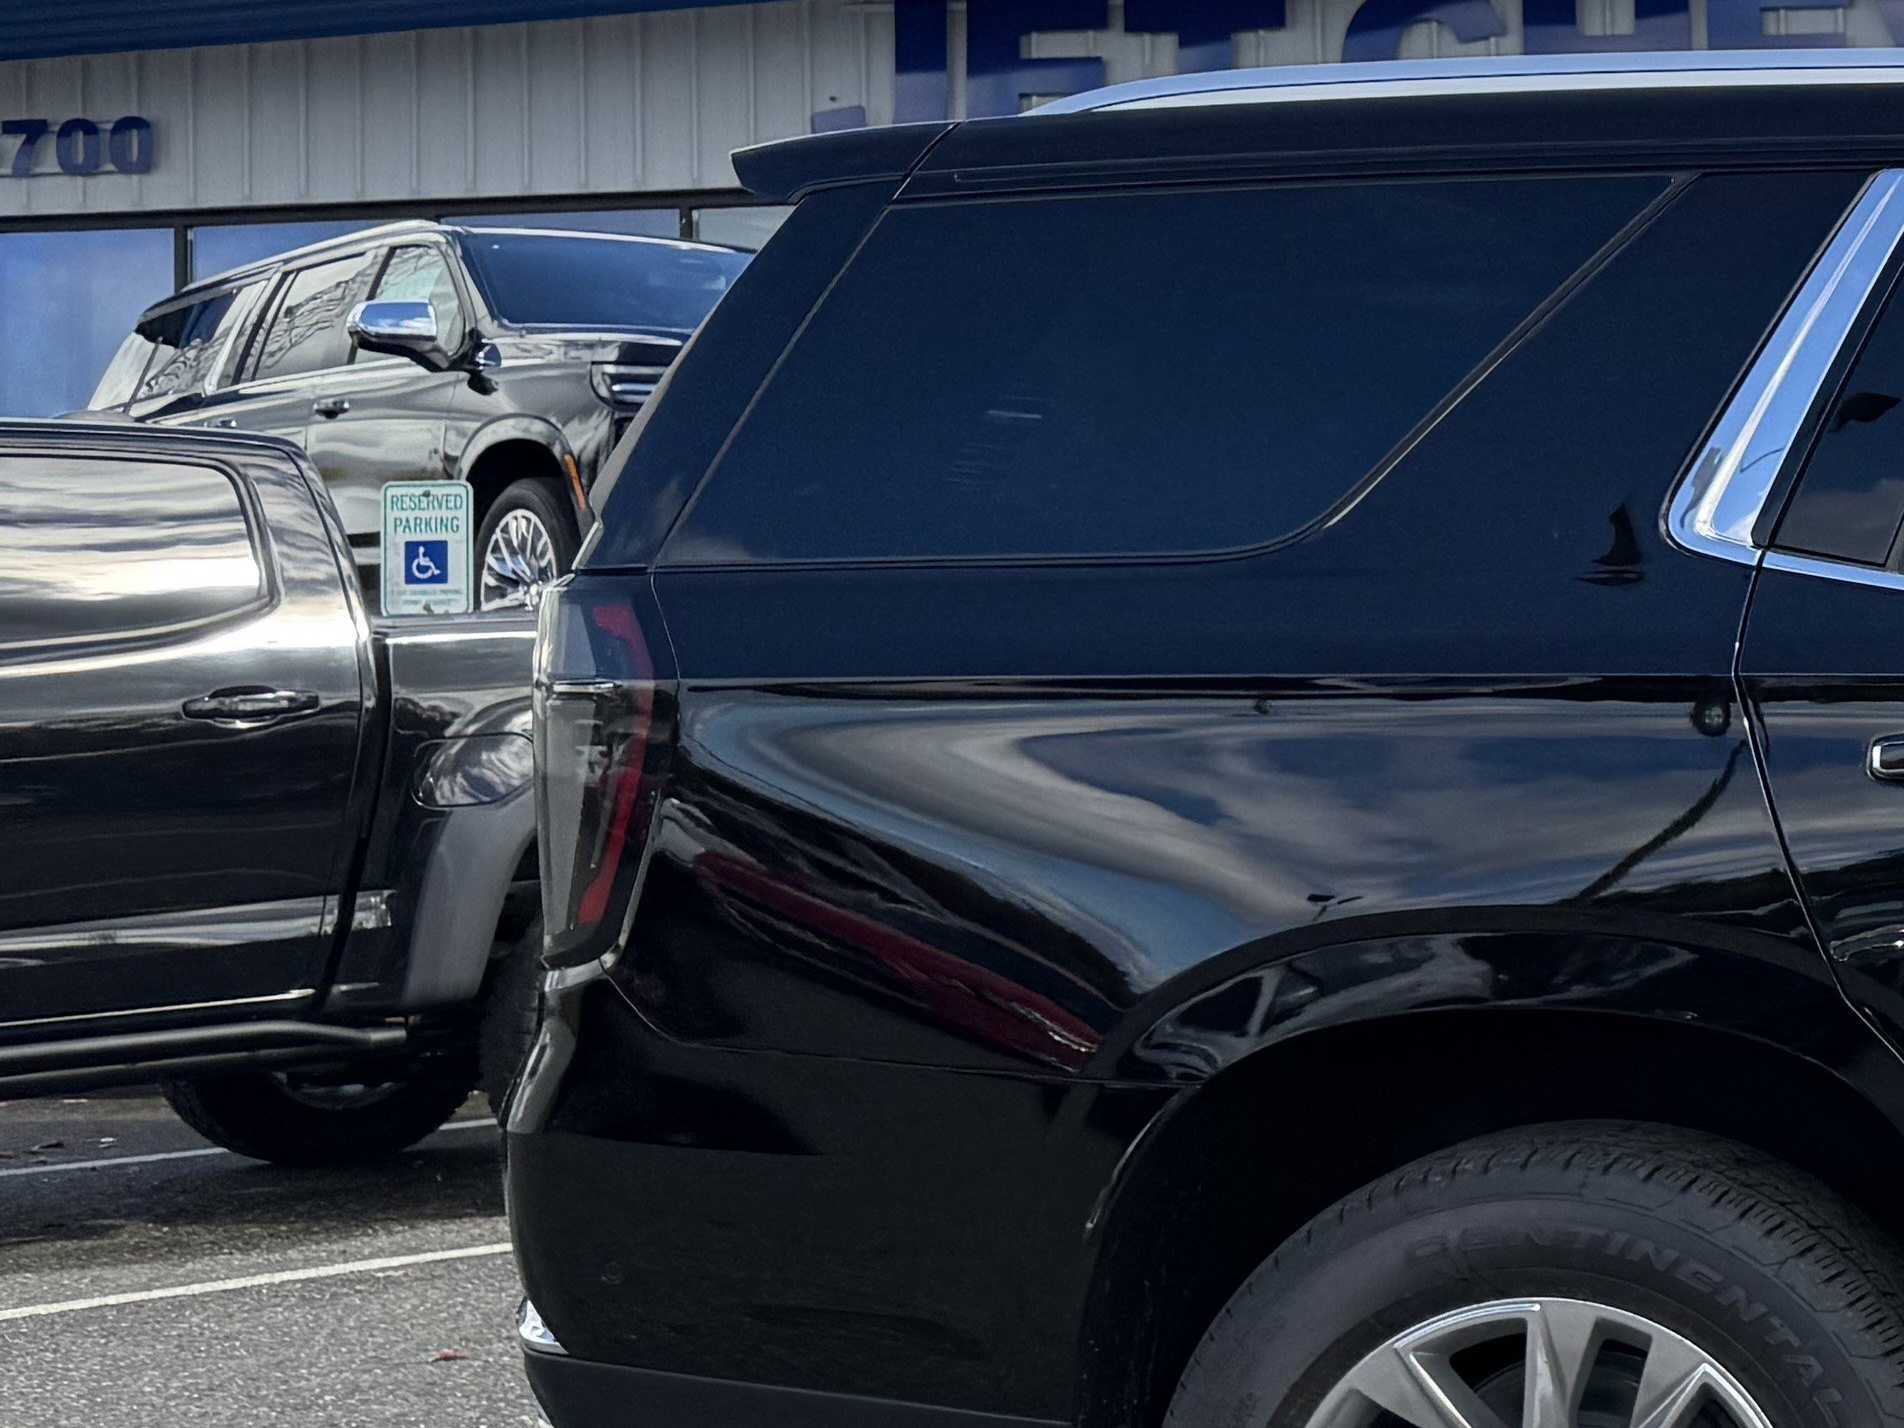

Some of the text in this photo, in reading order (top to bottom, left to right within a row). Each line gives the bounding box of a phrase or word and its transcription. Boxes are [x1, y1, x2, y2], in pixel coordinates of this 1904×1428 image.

[1, 116, 153, 177] 700
[391, 494, 463, 512] RESERVED
[394, 516, 460, 534] PARKING
